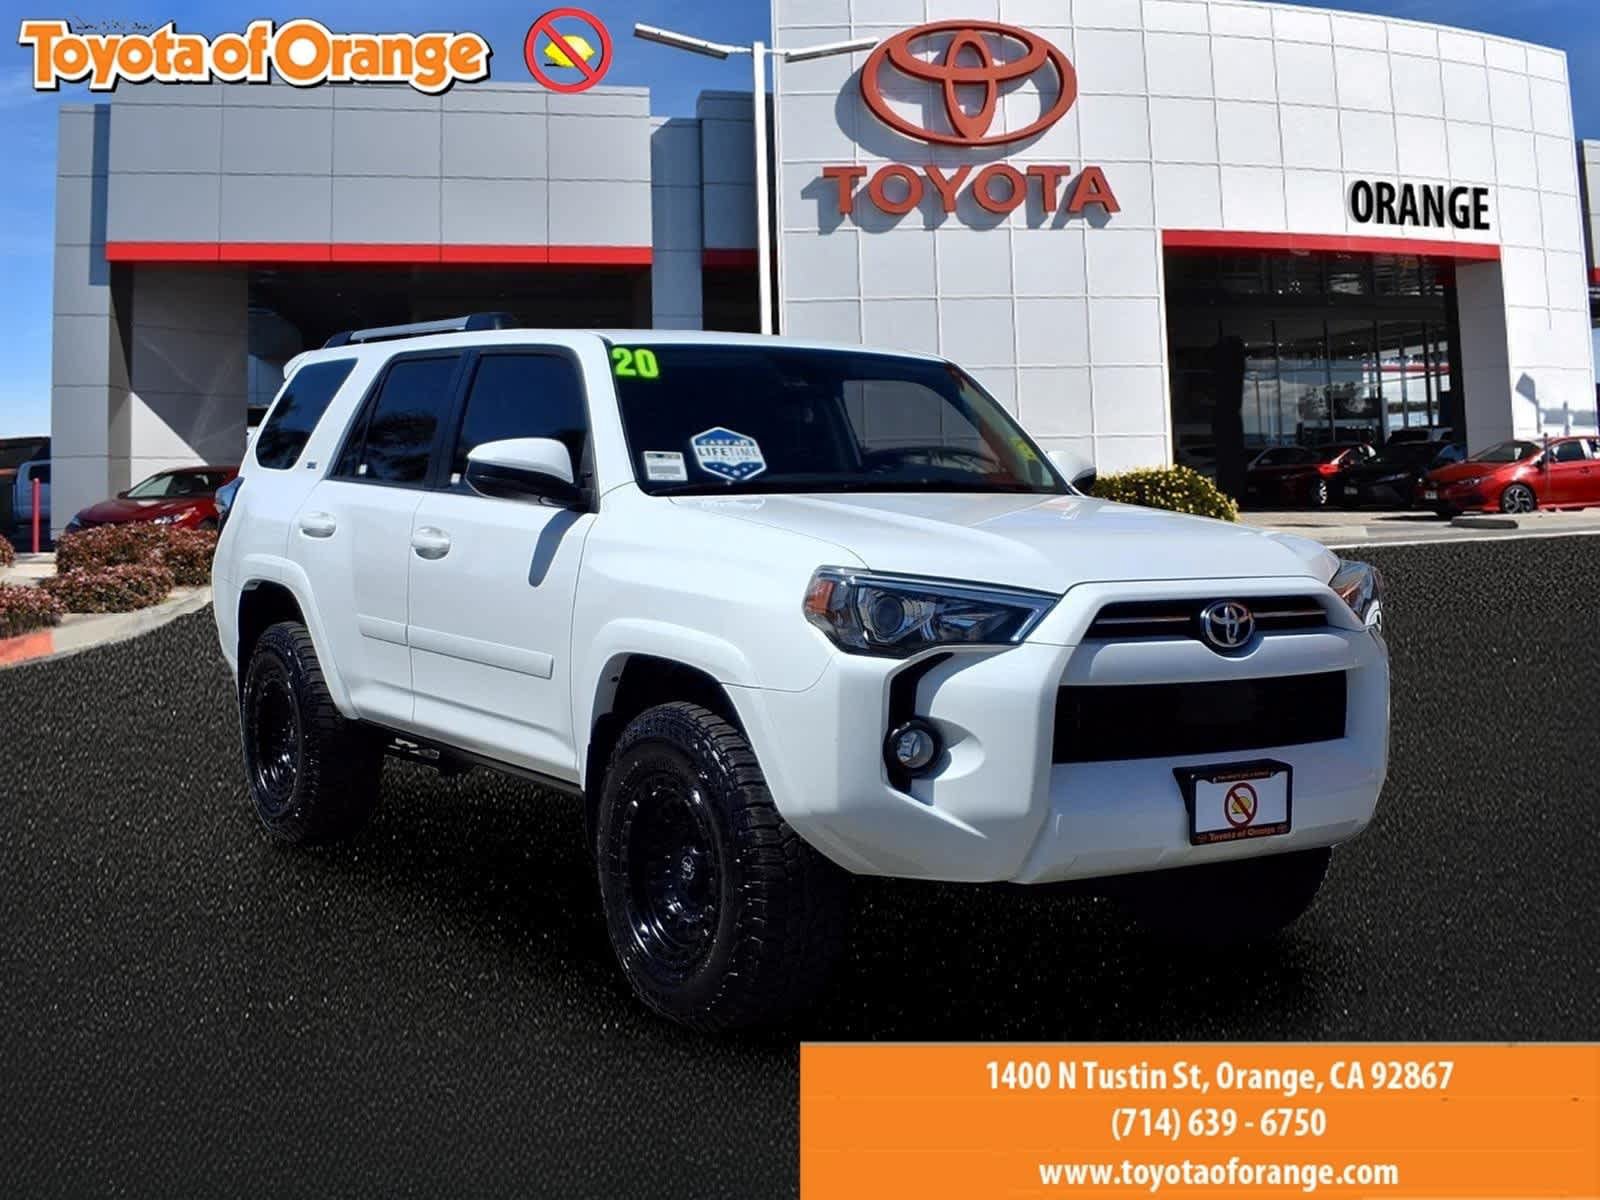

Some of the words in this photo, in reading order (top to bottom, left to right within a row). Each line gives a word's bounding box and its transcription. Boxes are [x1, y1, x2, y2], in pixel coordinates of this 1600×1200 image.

[825, 164, 1118, 214] TOYOTA
[1351, 180, 1490, 230] ORANGE
[611, 347, 660, 379] 20
